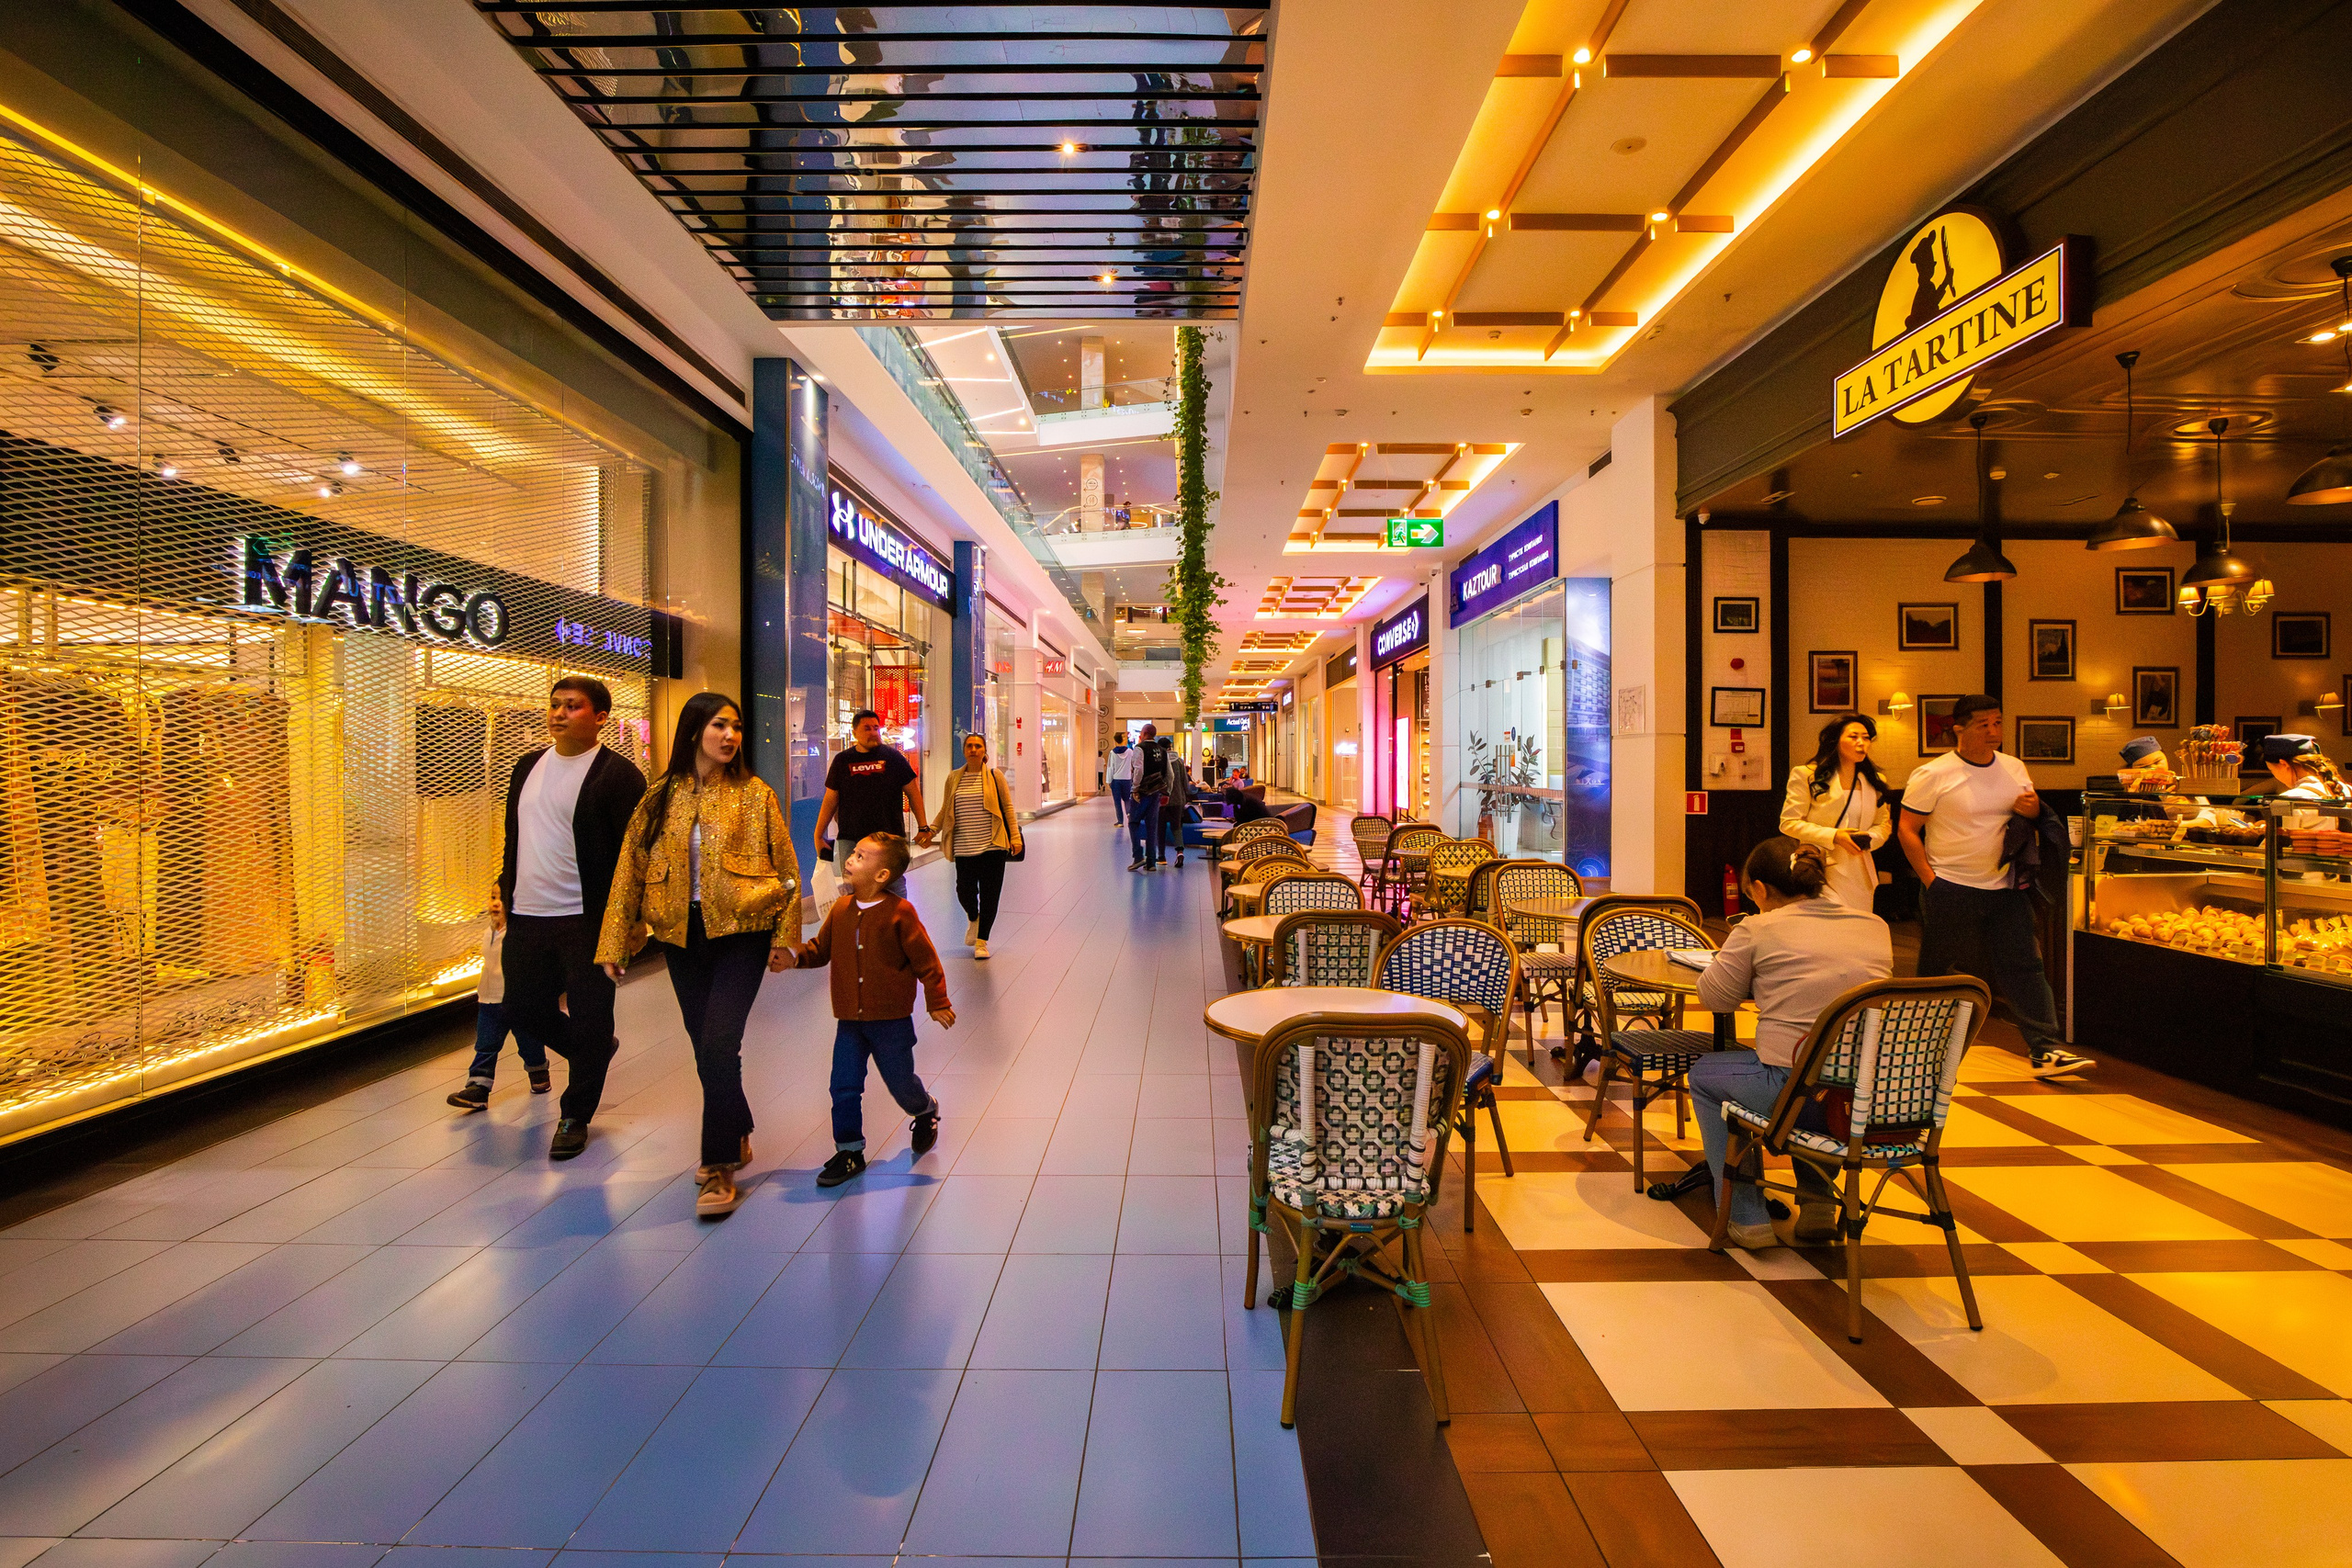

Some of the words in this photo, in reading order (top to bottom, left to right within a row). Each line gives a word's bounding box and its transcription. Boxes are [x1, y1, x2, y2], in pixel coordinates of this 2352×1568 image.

[1842, 375, 1879, 418] LA
[1883, 275, 2048, 395] TARTINE
[243, 536, 511, 647] MANGO
[858, 513, 905, 570] UNDER
[905, 549, 948, 599] ARMOUR
[1463, 563, 1498, 602] KAZTOUR
[1377, 616, 1412, 657] CONVERSE
